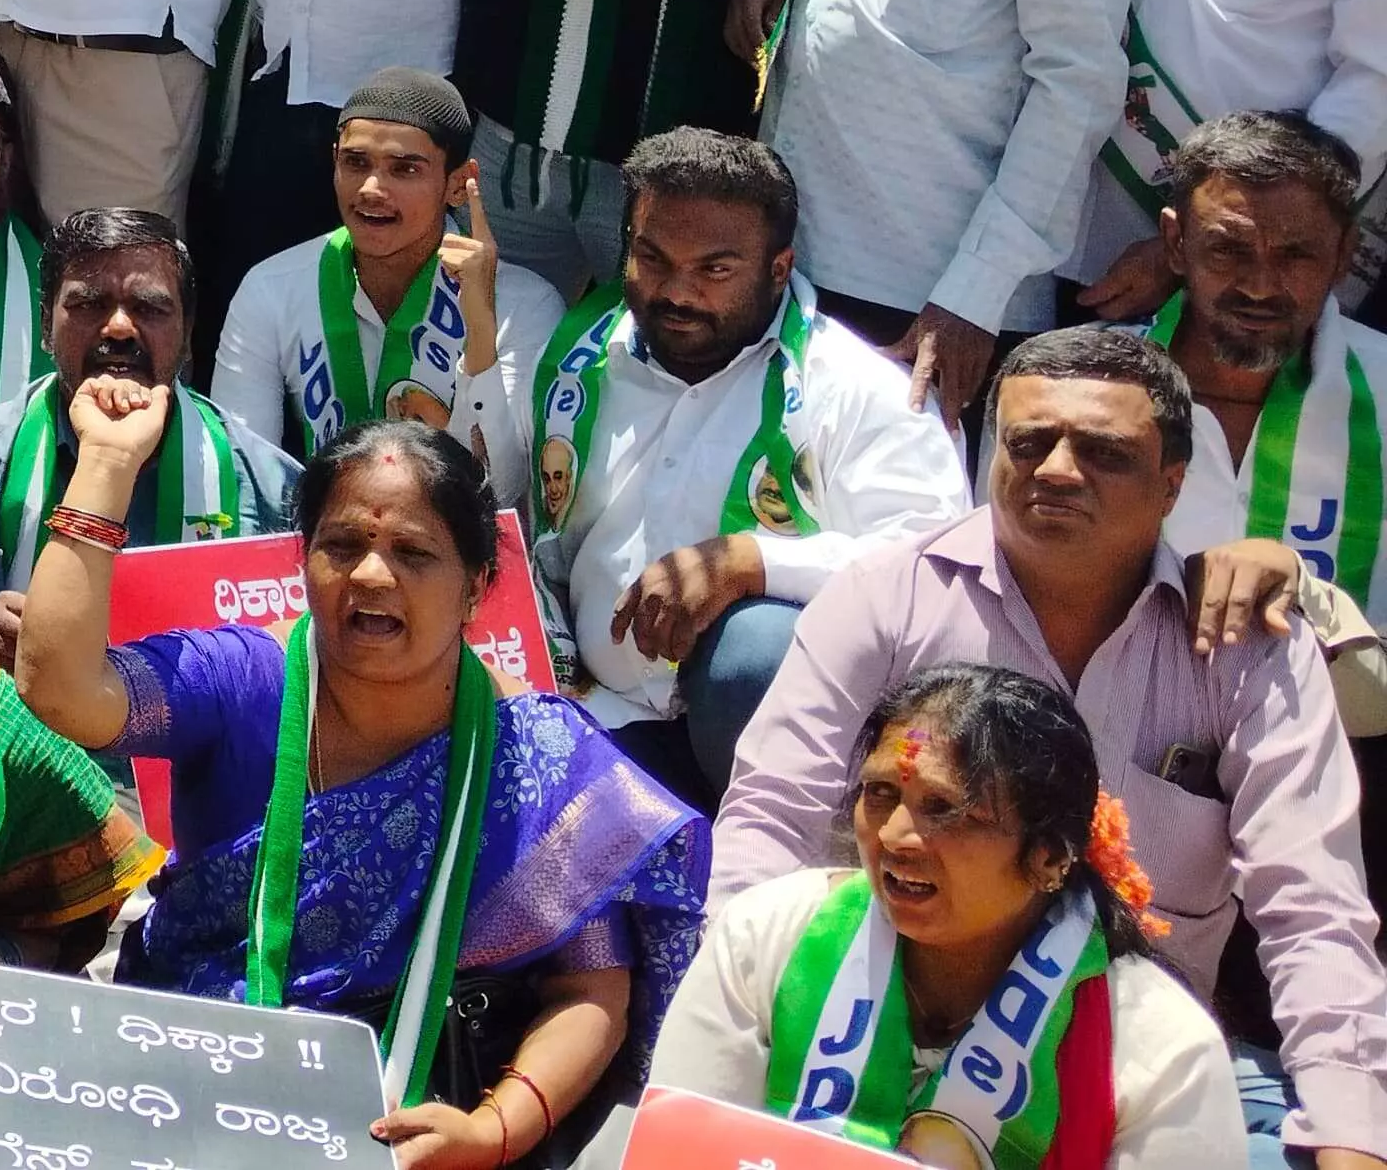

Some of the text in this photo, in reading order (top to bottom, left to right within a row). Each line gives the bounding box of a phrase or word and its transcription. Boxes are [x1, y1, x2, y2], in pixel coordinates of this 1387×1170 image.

[71, 1005, 82, 1034] !
[117, 1013, 265, 1075] ಧಿಕ್ಕಾರ
[300, 1041, 323, 1071] !!
[216, 1101, 348, 1161] ರಾಜ್ಯ
